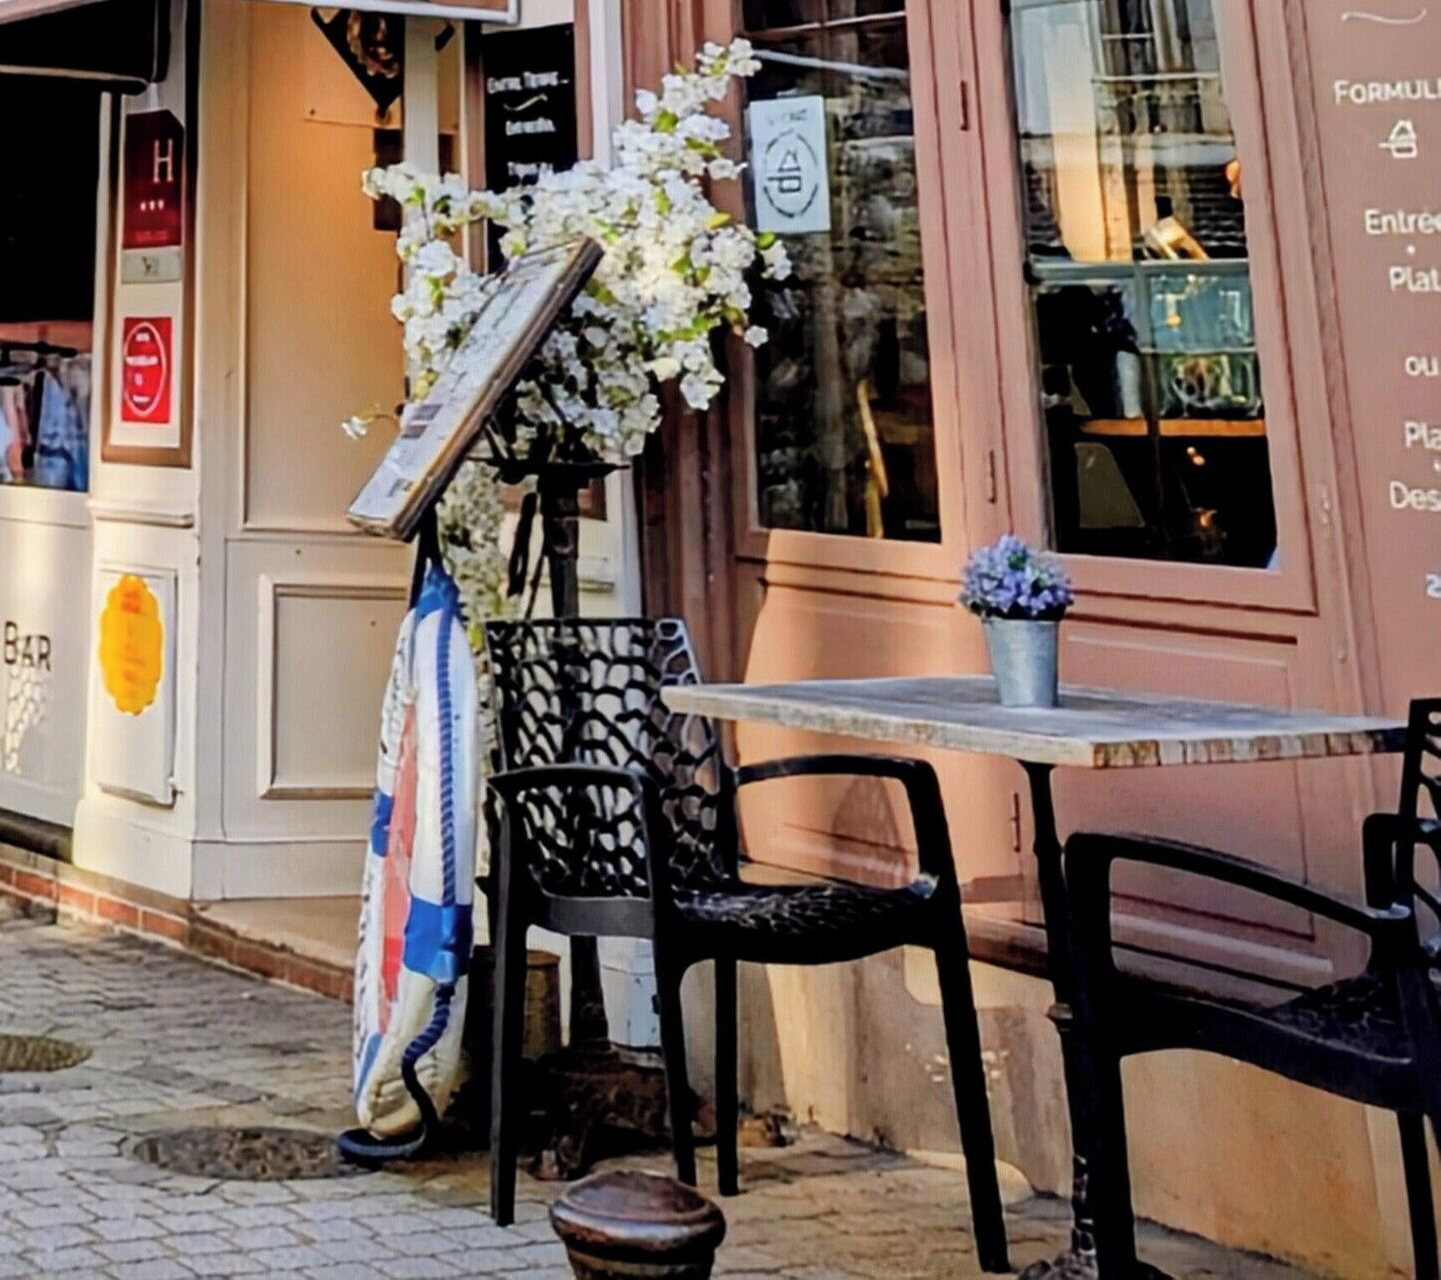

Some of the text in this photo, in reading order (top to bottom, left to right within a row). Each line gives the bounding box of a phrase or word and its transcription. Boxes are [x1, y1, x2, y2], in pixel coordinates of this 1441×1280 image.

[1334, 77, 1441, 105] FORMUL
[1405, 354, 1439, 377] ou
[4, 620, 51, 671] BAR
